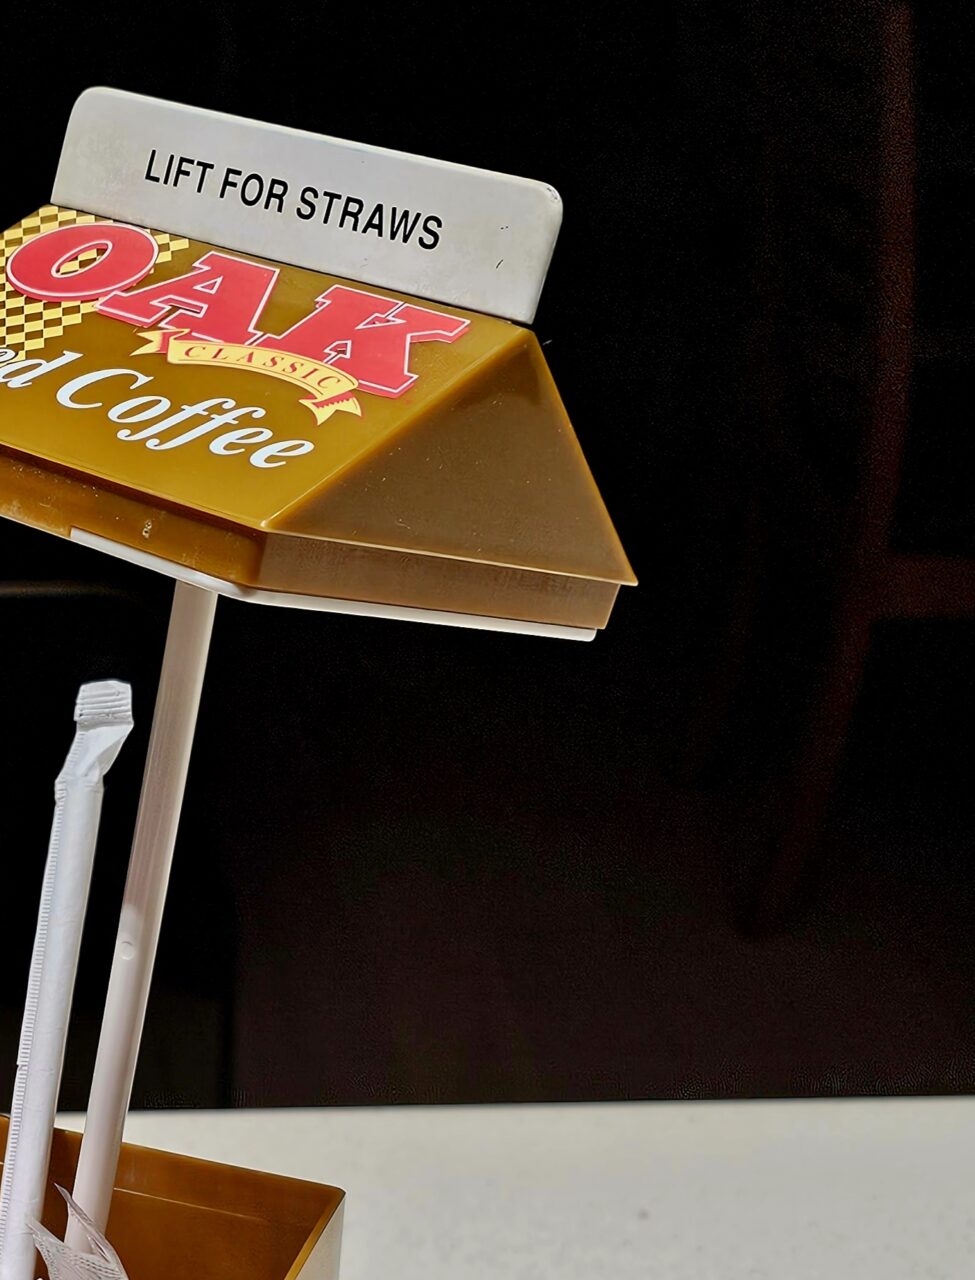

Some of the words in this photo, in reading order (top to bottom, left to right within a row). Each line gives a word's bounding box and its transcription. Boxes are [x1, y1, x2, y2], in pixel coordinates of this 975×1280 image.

[143, 148, 215, 195] LIFT
[219, 167, 289, 214] FOR
[295, 187, 443, 250] STRAWS
[5, 224, 471, 398] OAK
[55, 368, 315, 470] Coffee
[184, 343, 342, 393] CLASSIC
